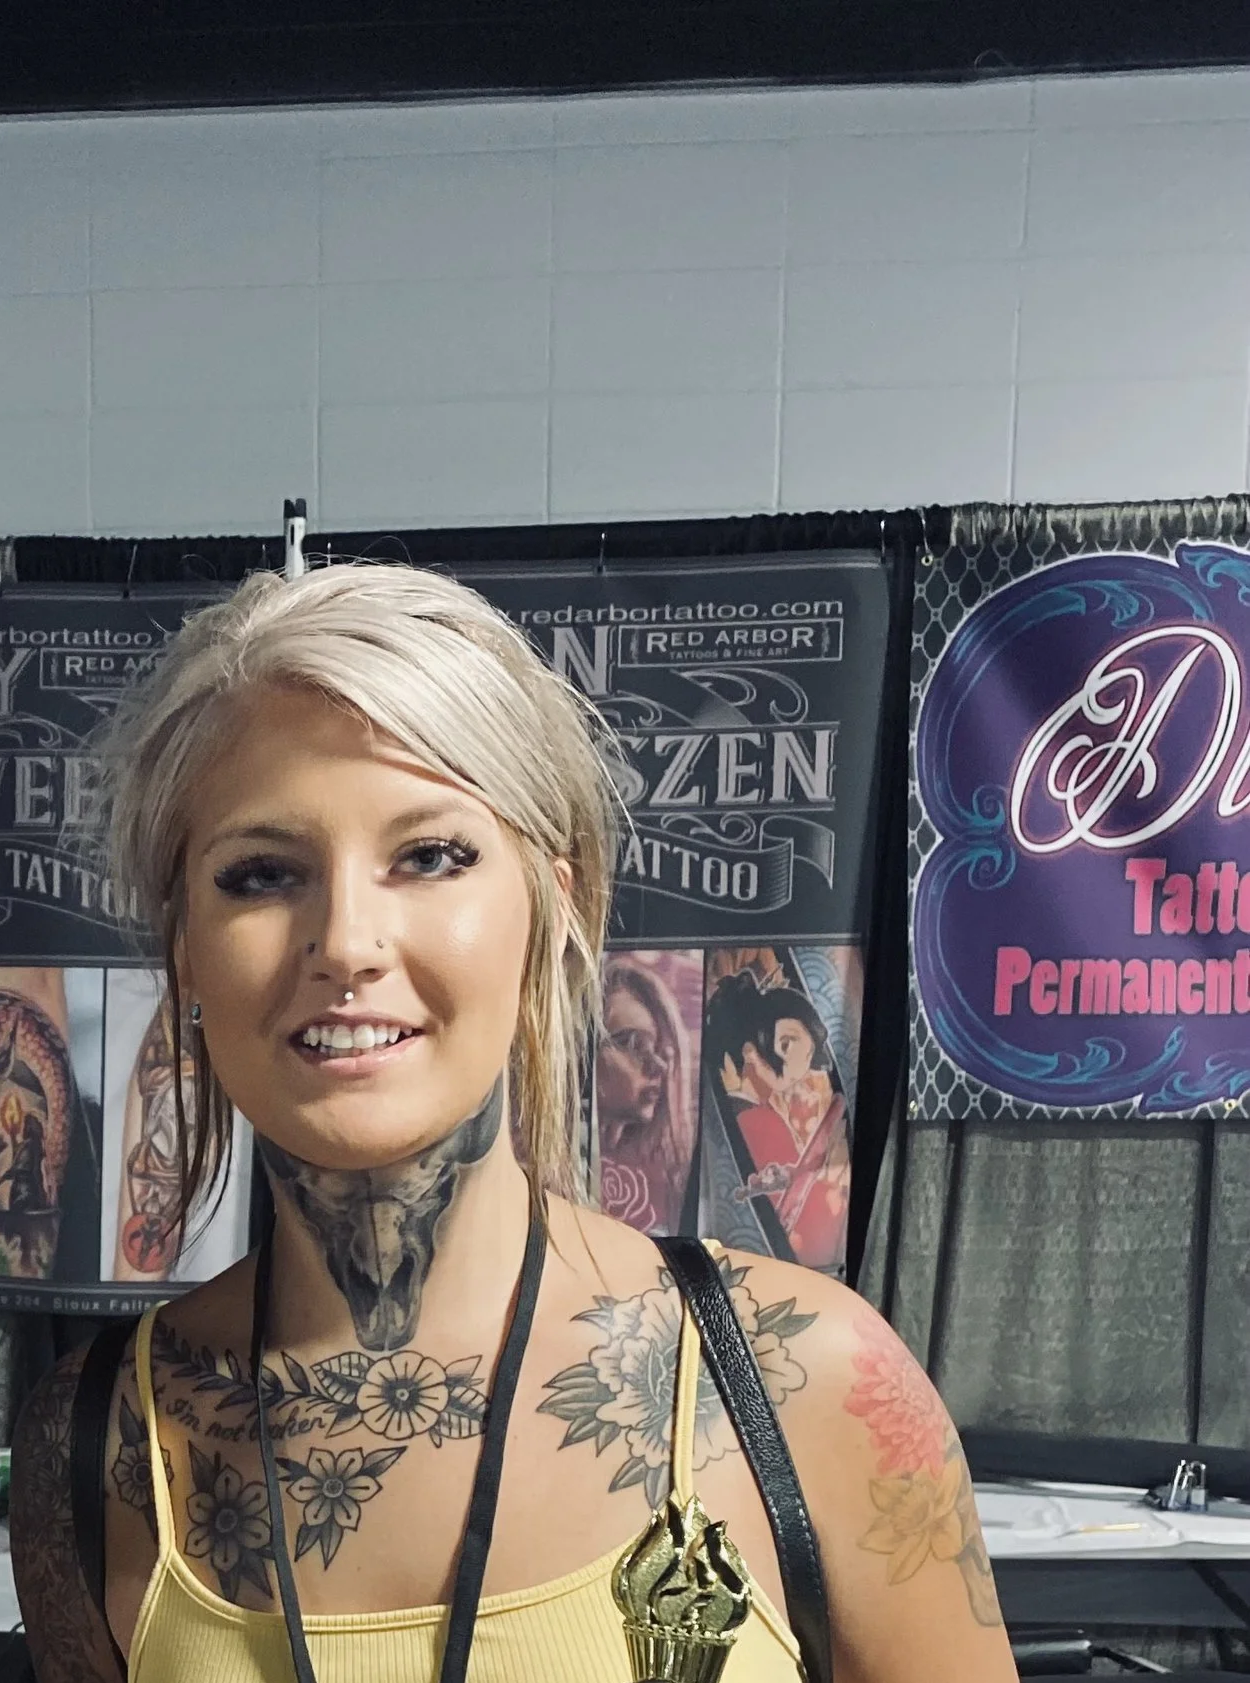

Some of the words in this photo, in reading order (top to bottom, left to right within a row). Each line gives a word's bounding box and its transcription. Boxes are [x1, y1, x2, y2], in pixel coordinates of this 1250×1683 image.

[646, 629, 704, 654] RED
[715, 626, 815, 650] ARBOR
[64, 655, 114, 677] RED
[619, 832, 759, 902] ATTOO
